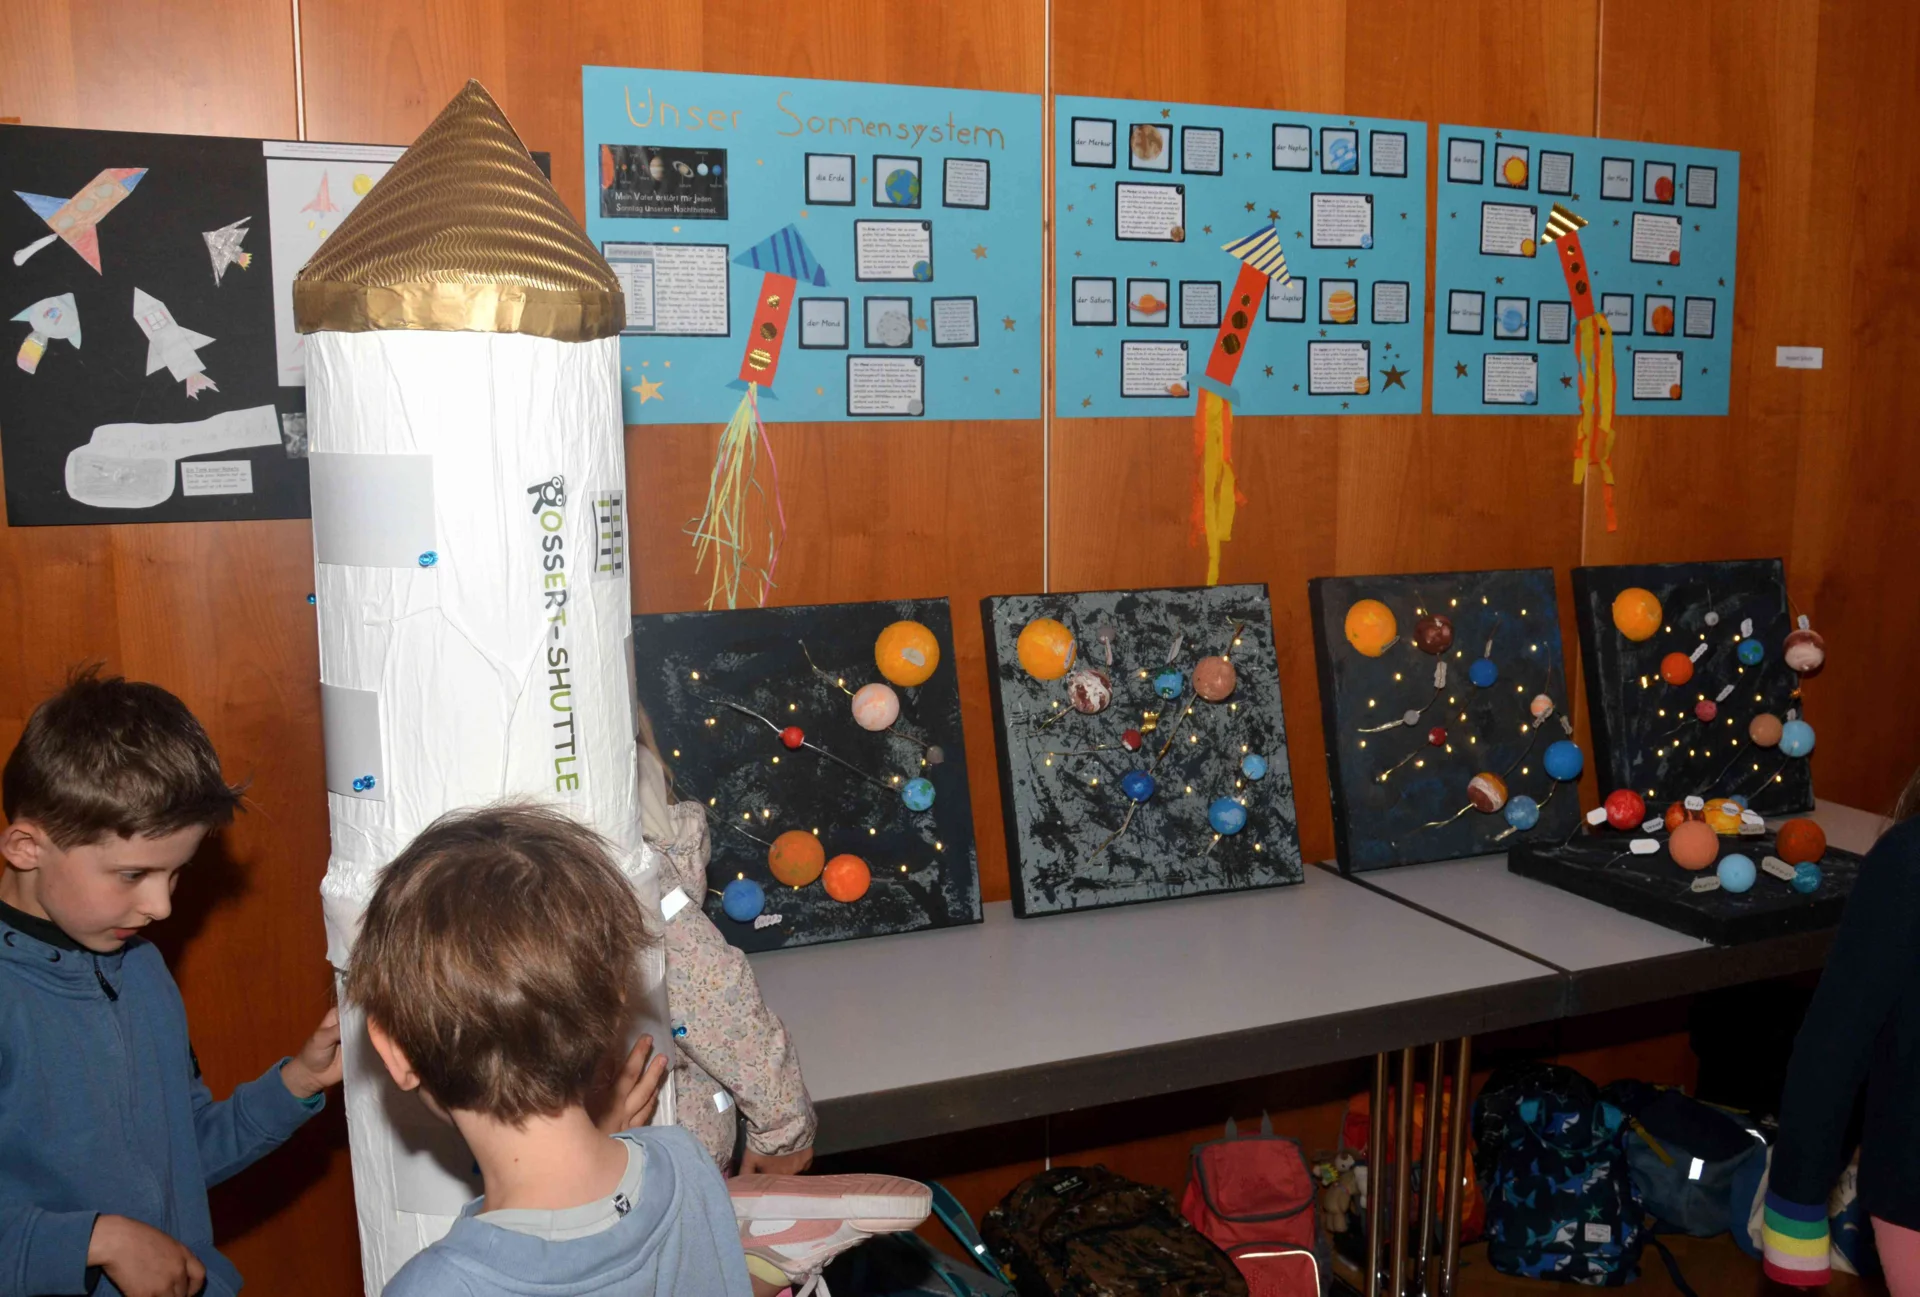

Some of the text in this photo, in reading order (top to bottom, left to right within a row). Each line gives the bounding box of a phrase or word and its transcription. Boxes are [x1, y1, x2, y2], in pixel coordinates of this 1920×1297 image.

[624, 86, 1005, 150] Unser Sonnensystem
[1088, 138, 1112, 147] Merkur
[815, 173, 845, 182] die Erde
[615, 191, 632, 200] Mein
[634, 192, 653, 201] Vater
[616, 203, 718, 214] Sonntag unseren Nachthimmel.
[1089, 295, 1112, 304] Saturn
[806, 318, 841, 327] der Mond
